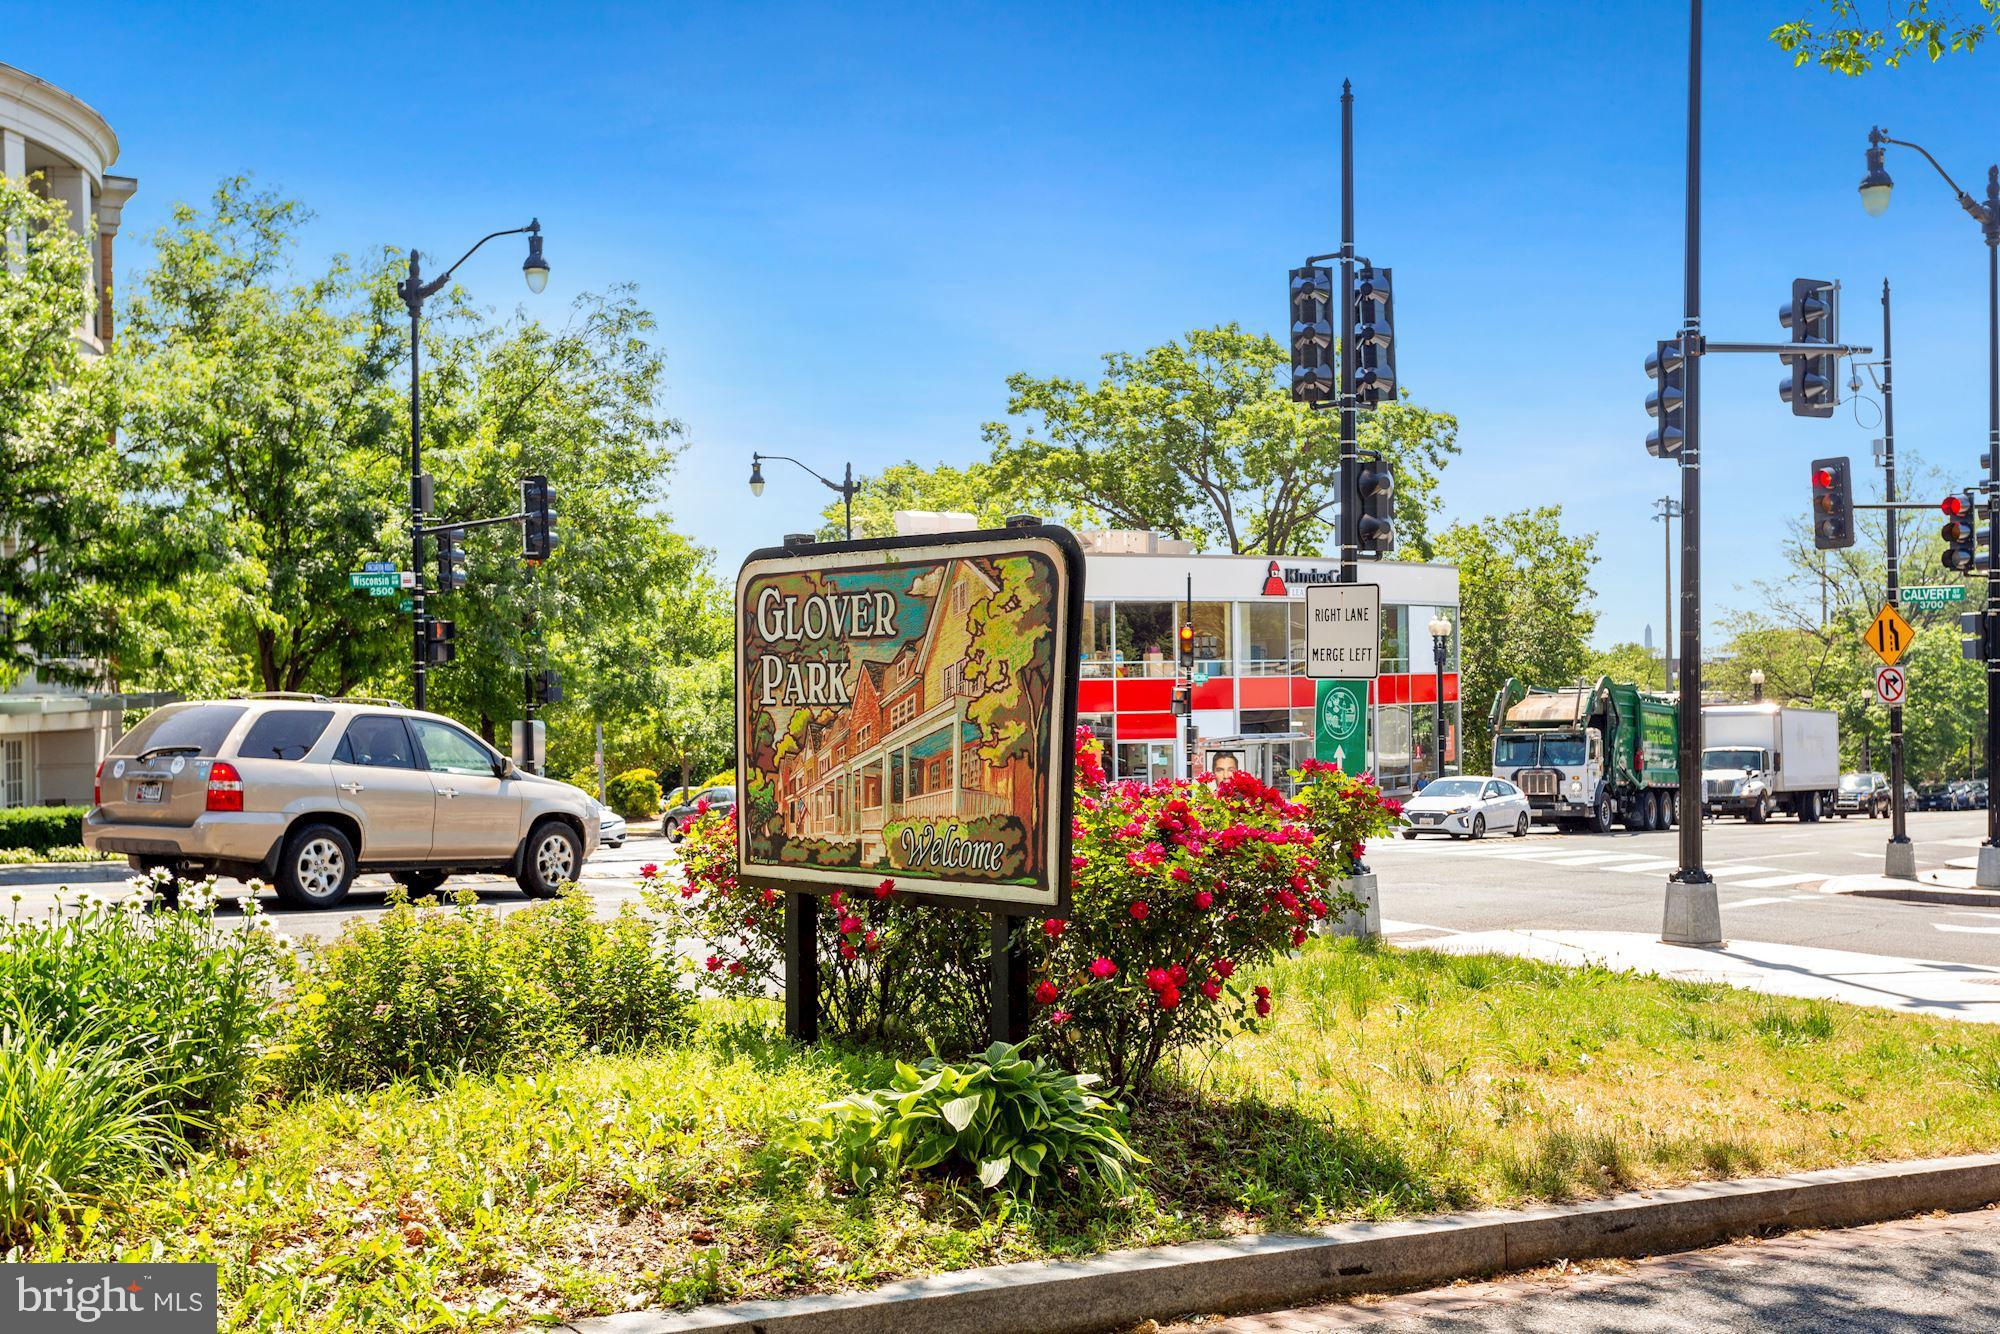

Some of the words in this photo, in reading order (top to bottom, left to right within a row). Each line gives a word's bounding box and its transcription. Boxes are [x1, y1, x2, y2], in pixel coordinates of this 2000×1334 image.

[352, 575, 390, 586] Wisconsin
[370, 587, 394, 596] 2500
[1902, 588, 1951, 601] CALVERT
[1920, 601, 1944, 609] 3700
[757, 588, 897, 643] GLOVER
[1315, 608, 1342, 622] RIGHT
[1345, 607, 1369, 621] LANE
[1312, 648, 1345, 662] MERGE
[1349, 648, 1373, 662] LEFT
[759, 655, 851, 706] PARK
[901, 825, 1005, 872] Welcome
